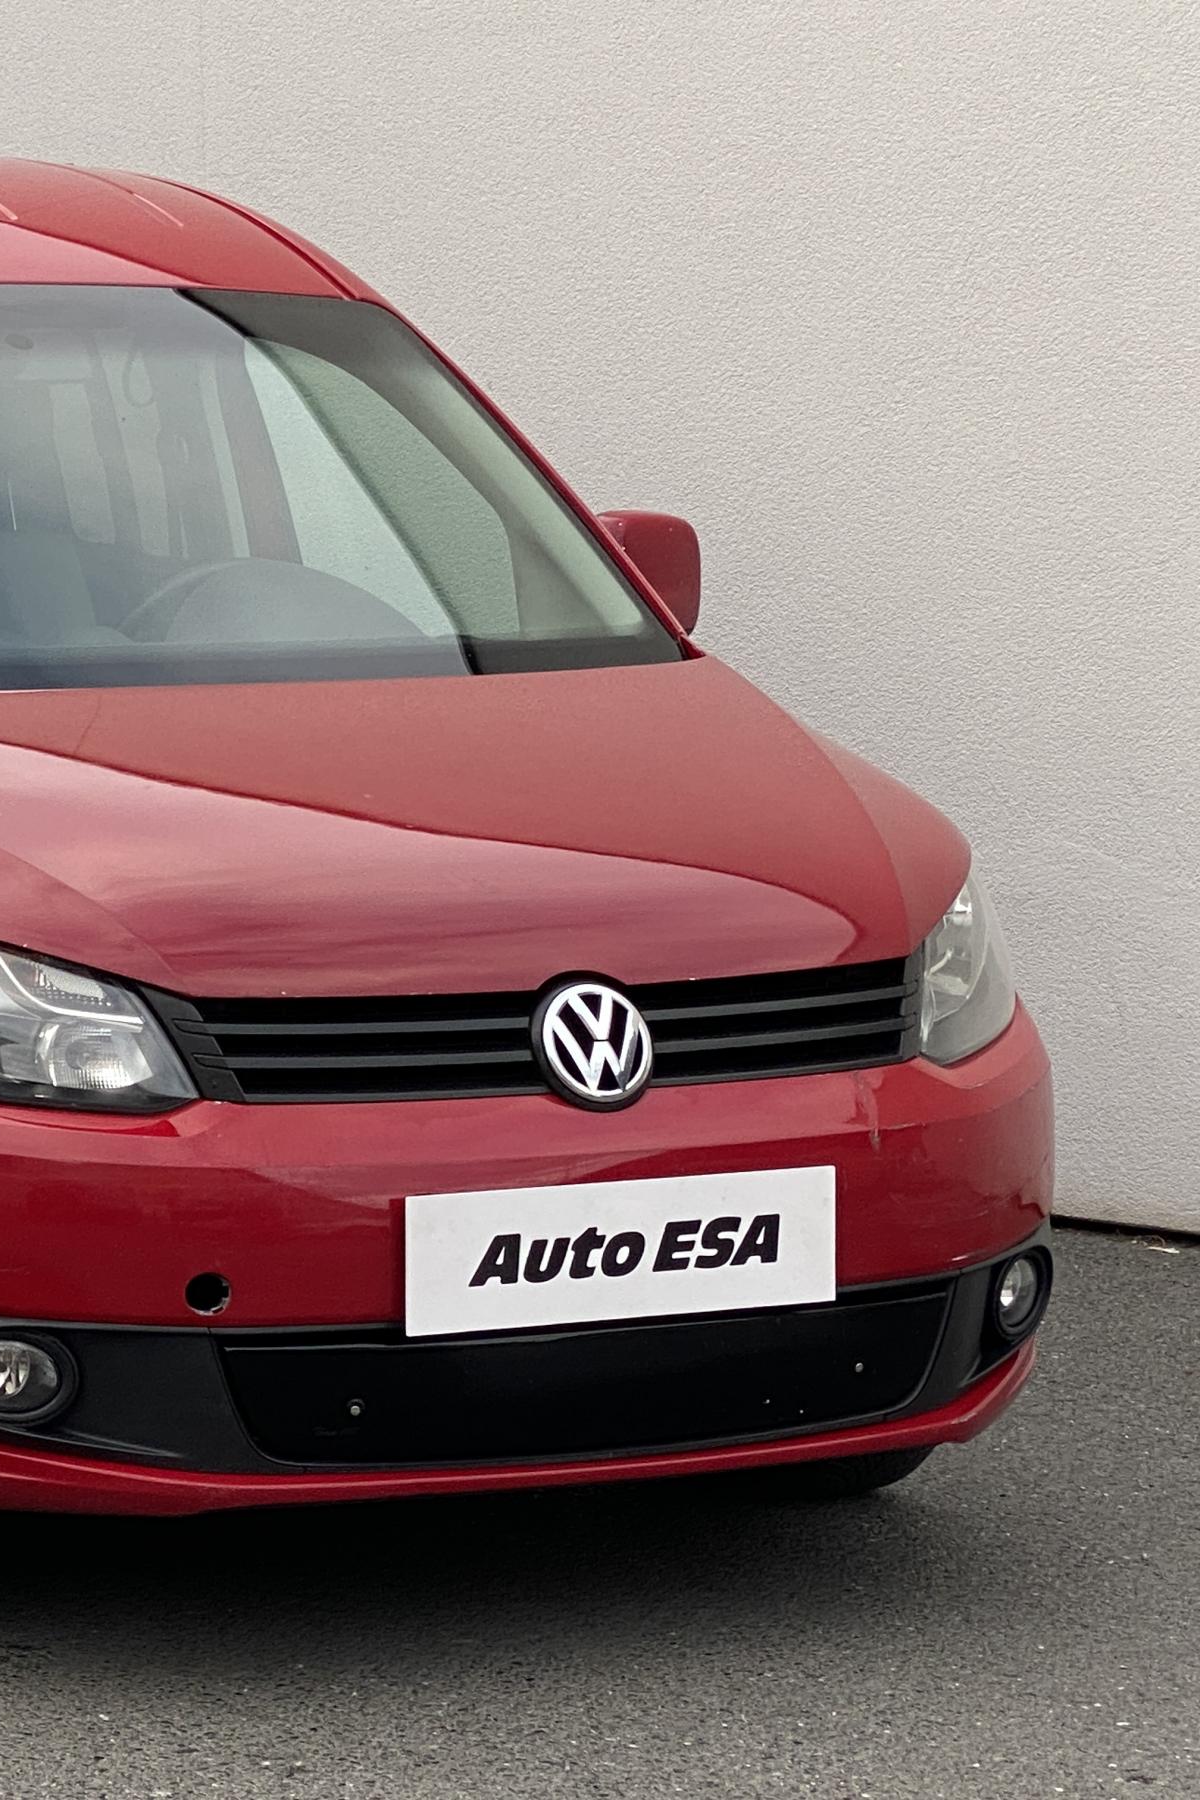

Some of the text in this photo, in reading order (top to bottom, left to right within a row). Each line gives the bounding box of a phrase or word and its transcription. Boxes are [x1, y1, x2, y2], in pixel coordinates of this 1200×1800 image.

[545, 986, 648, 1099] VW
[468, 1213, 781, 1288] Auto ESA
